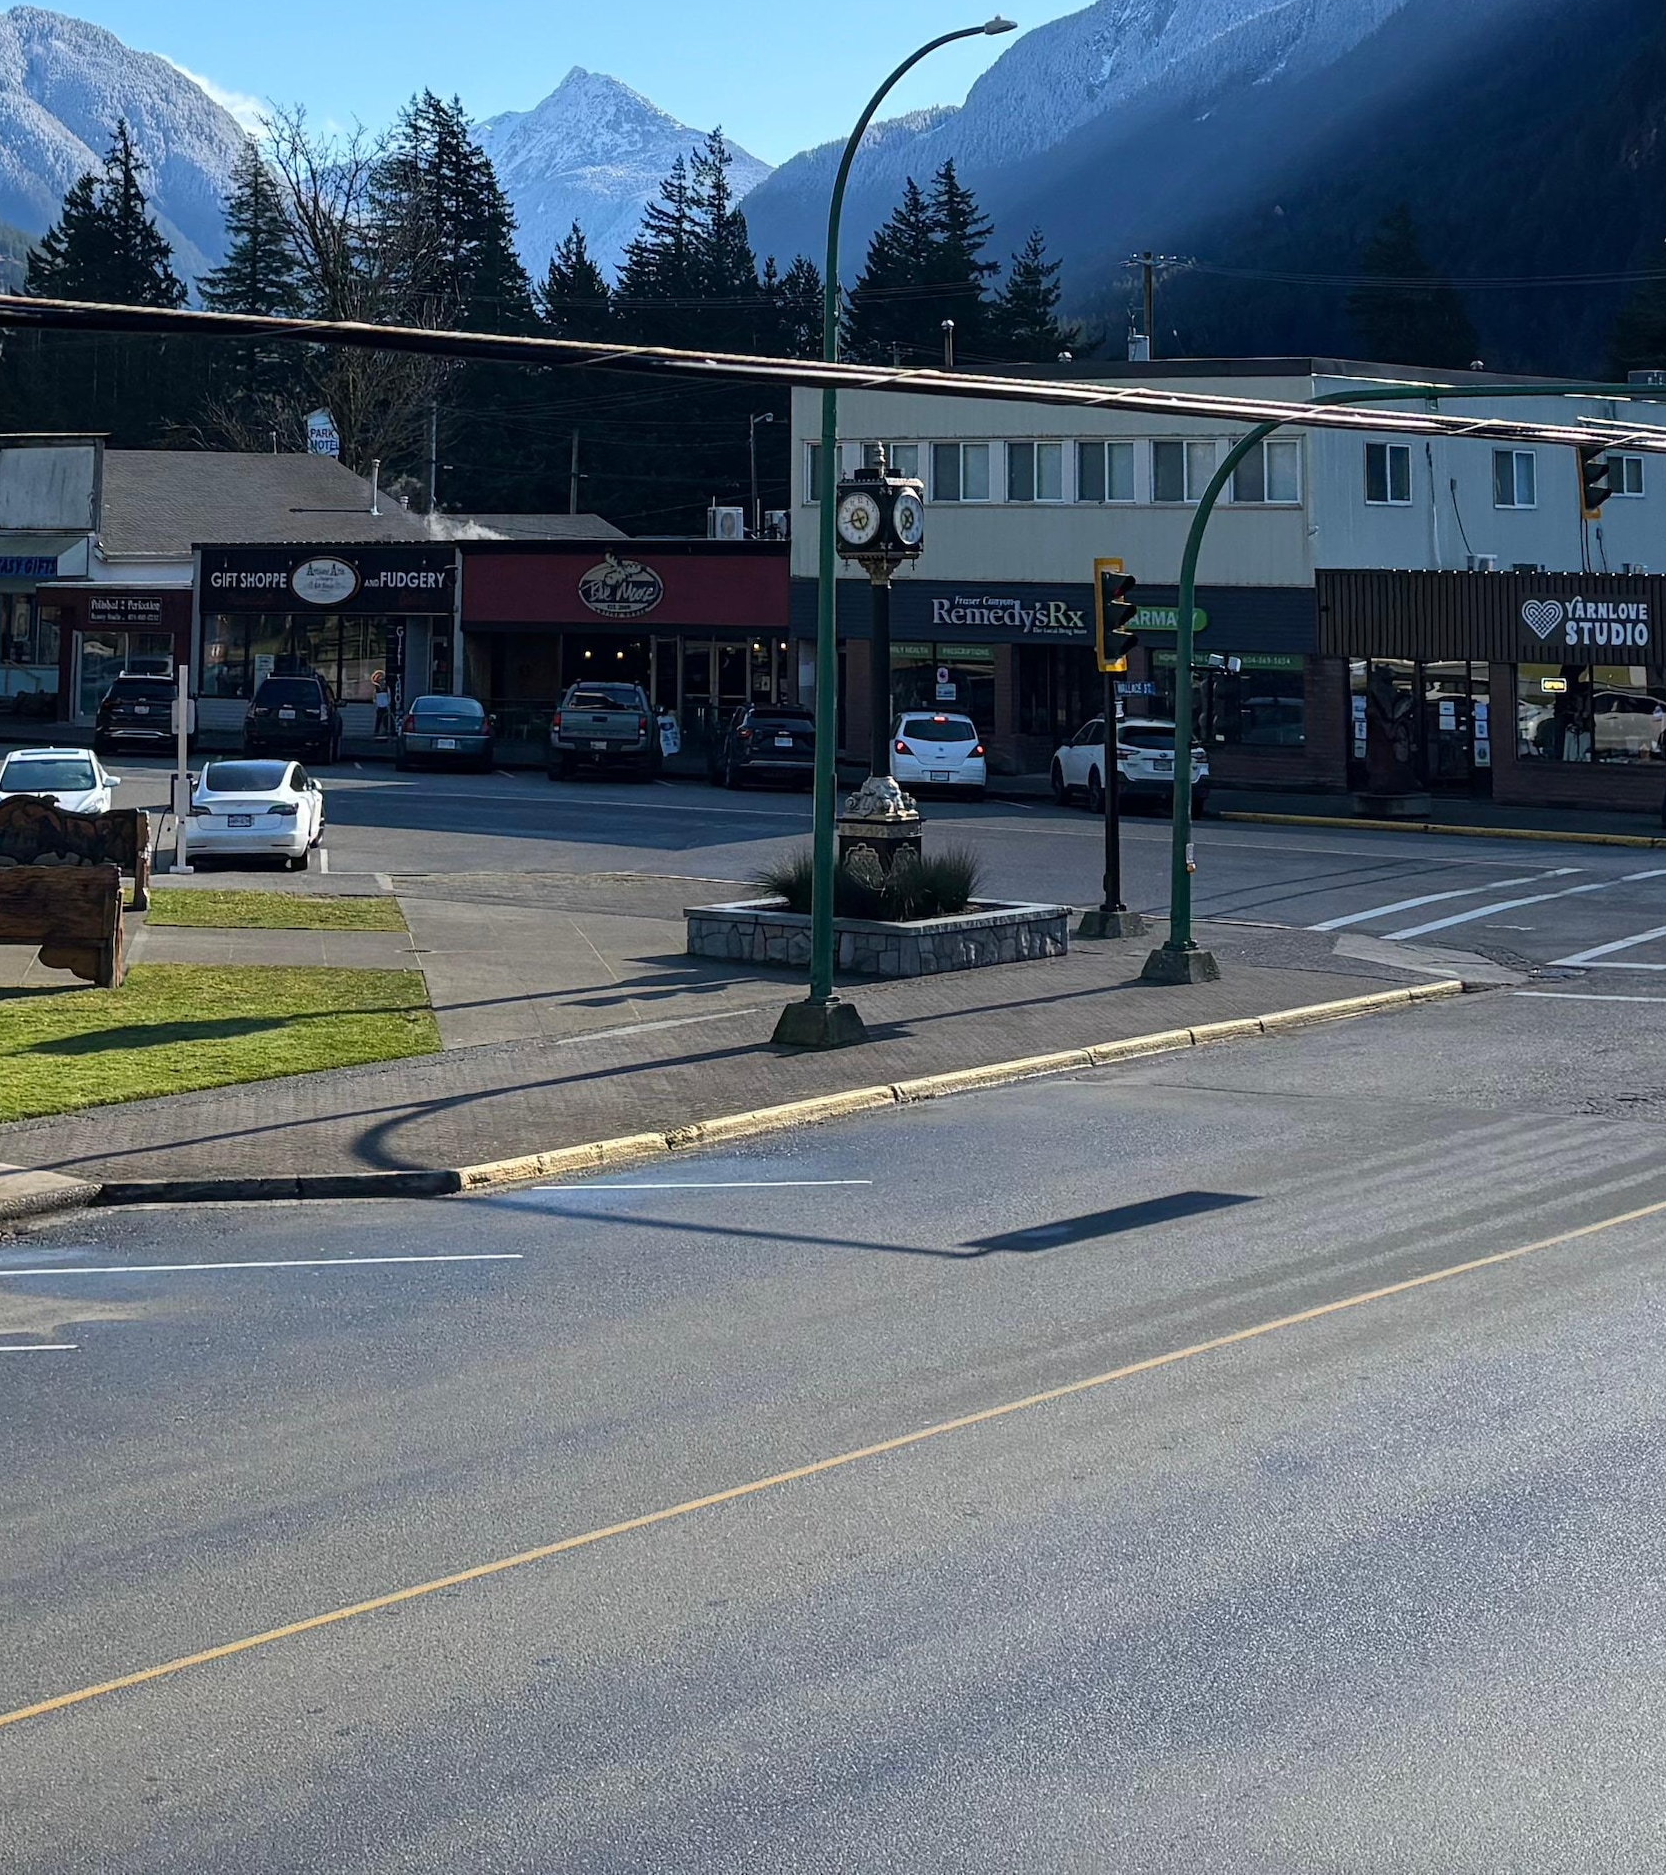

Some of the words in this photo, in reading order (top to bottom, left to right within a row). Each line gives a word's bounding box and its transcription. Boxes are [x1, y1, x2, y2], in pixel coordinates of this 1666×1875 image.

[310, 428, 335, 438] PARK
[24, 557, 57, 574] GIFTS
[211, 572, 238, 588] GIFT
[240, 572, 287, 588] SHOPPE
[364, 578, 379, 587] AND
[380, 572, 446, 588] FUDGERY
[954, 595, 980, 606] Fraser
[982, 595, 1015, 608] Canyon
[1565, 595, 1648, 620] YARNLOVE
[1565, 620, 1649, 647] STUDIO
